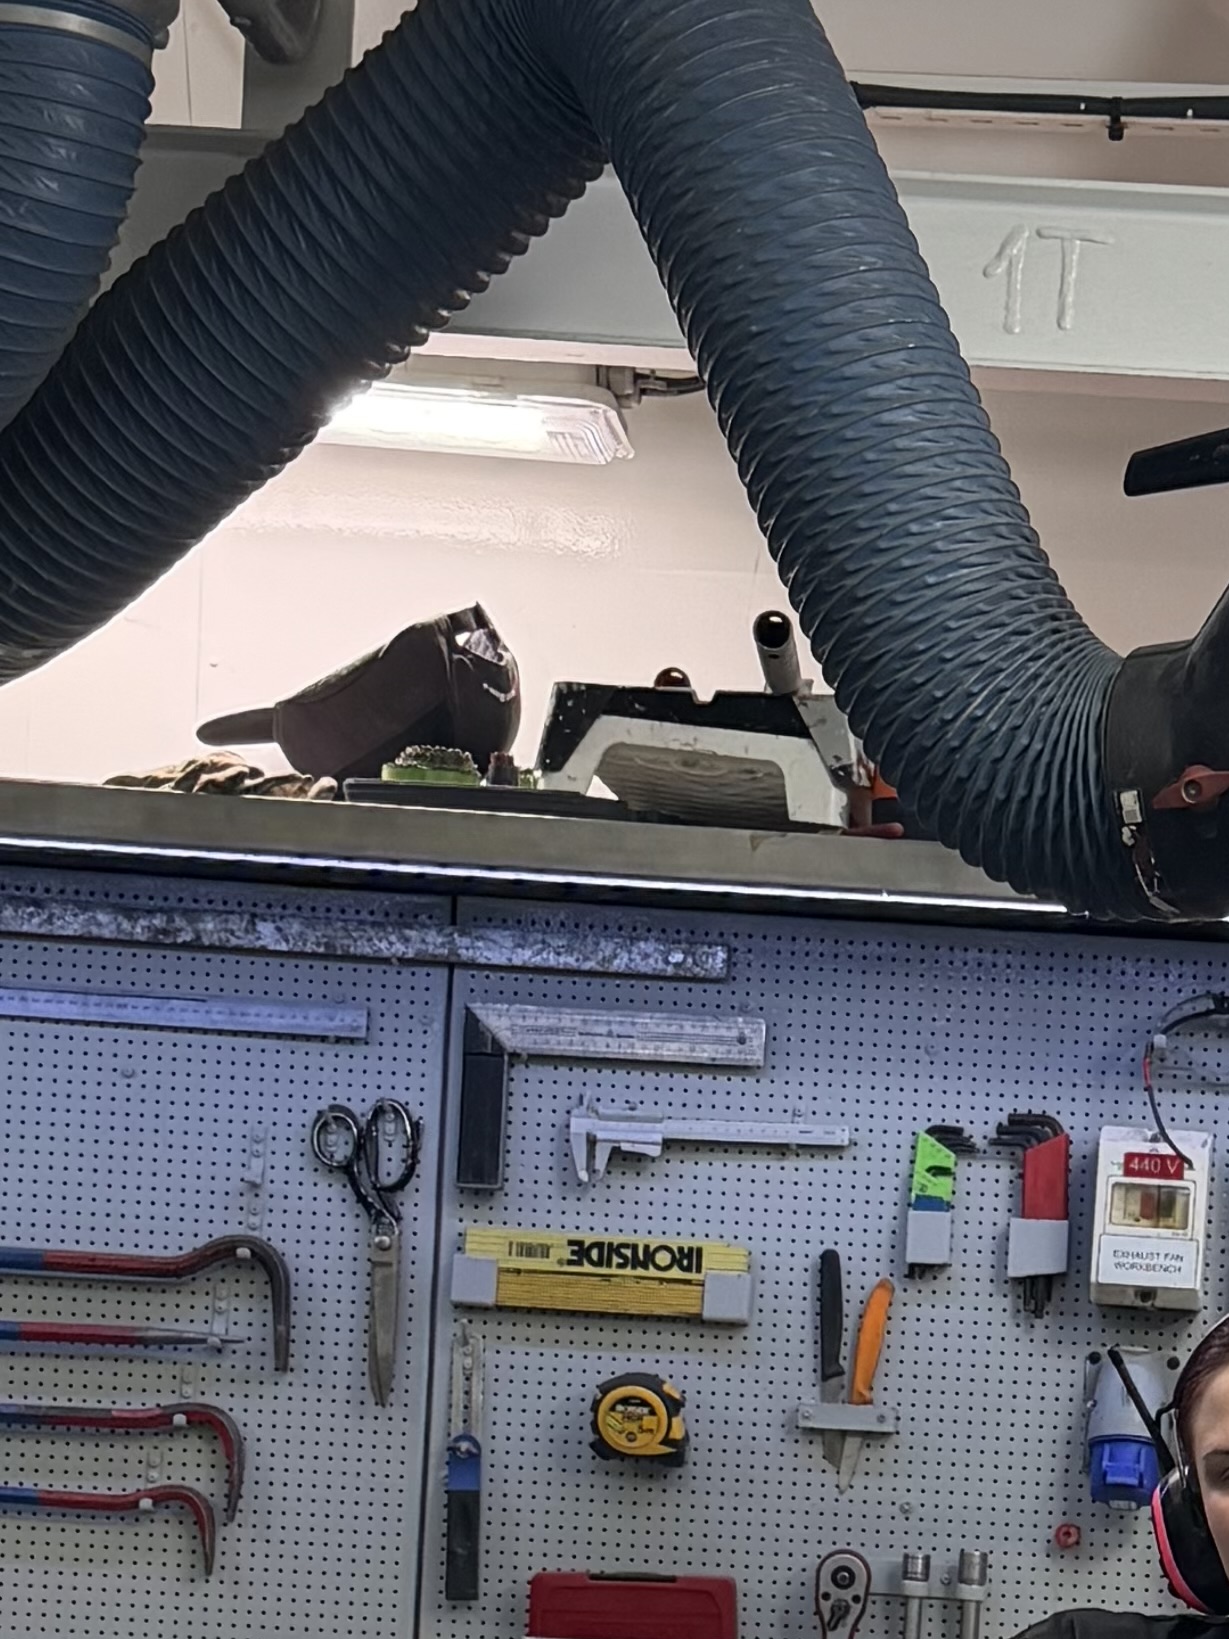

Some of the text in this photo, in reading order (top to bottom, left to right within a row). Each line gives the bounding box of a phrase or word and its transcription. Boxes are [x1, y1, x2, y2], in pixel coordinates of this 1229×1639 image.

[983, 223, 1115, 335] 1T
[1128, 1156, 1180, 1175] 440 V
[566, 1239, 703, 1274] IRONSIDE
[1112, 1249, 1184, 1263] EXHAUST FAN
[1113, 1261, 1183, 1274] WORKBENCH
